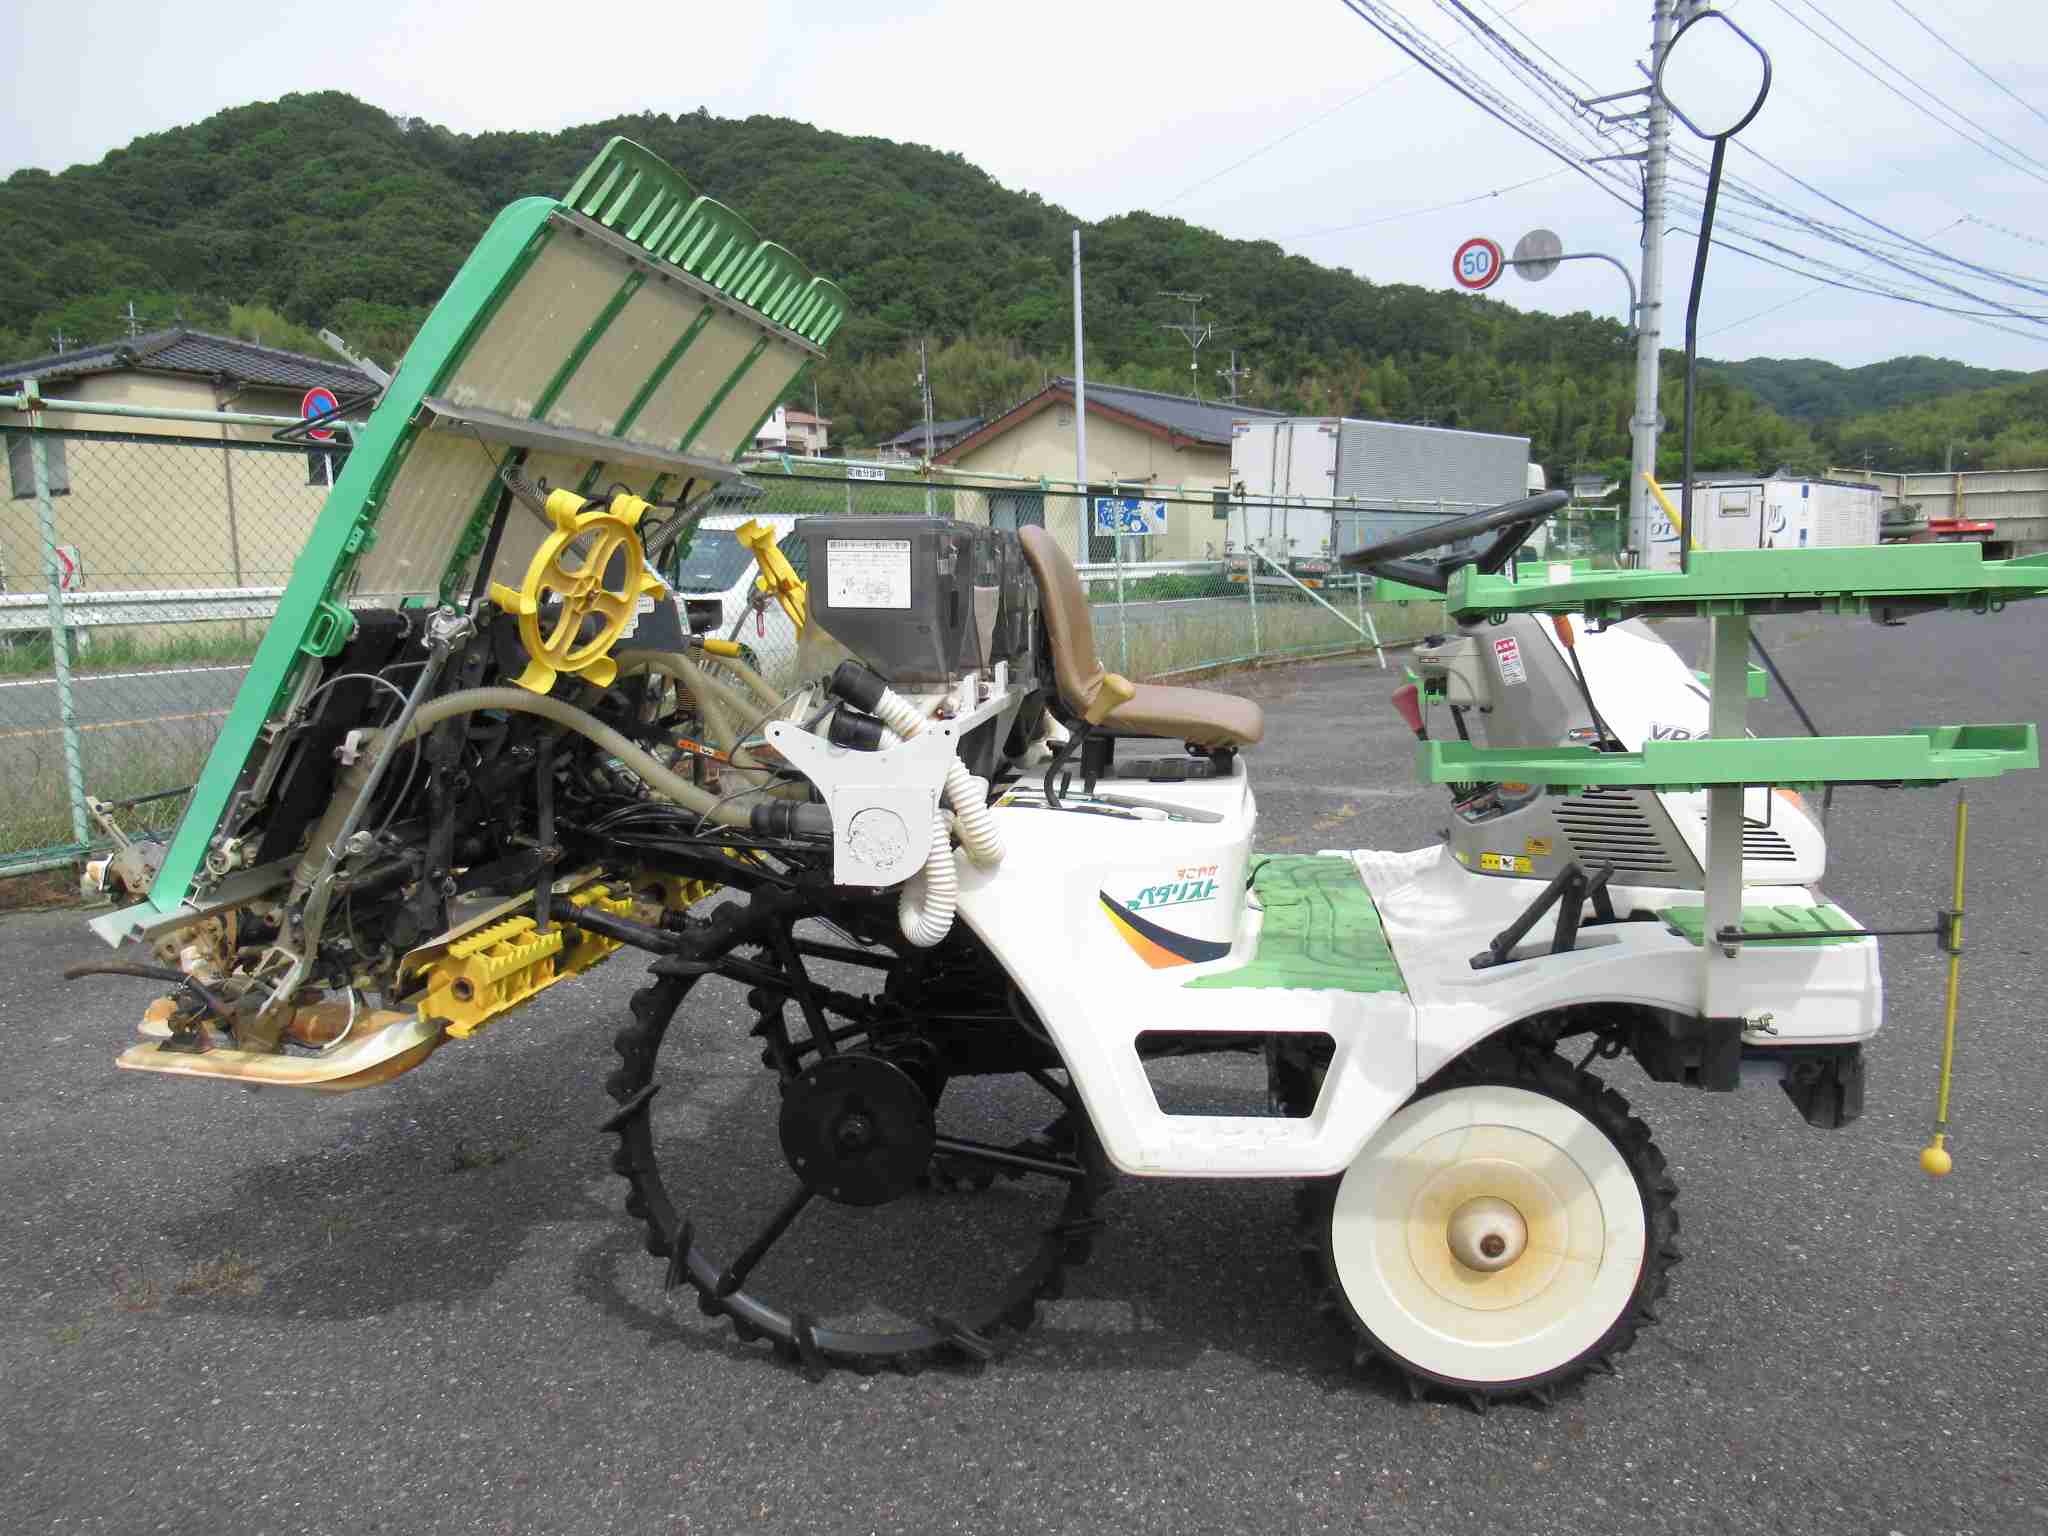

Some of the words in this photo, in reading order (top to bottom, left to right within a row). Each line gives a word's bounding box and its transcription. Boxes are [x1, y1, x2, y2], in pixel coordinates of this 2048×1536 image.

[1464, 251, 1488, 275] 50
[1138, 878, 1220, 905] ペダリスト
